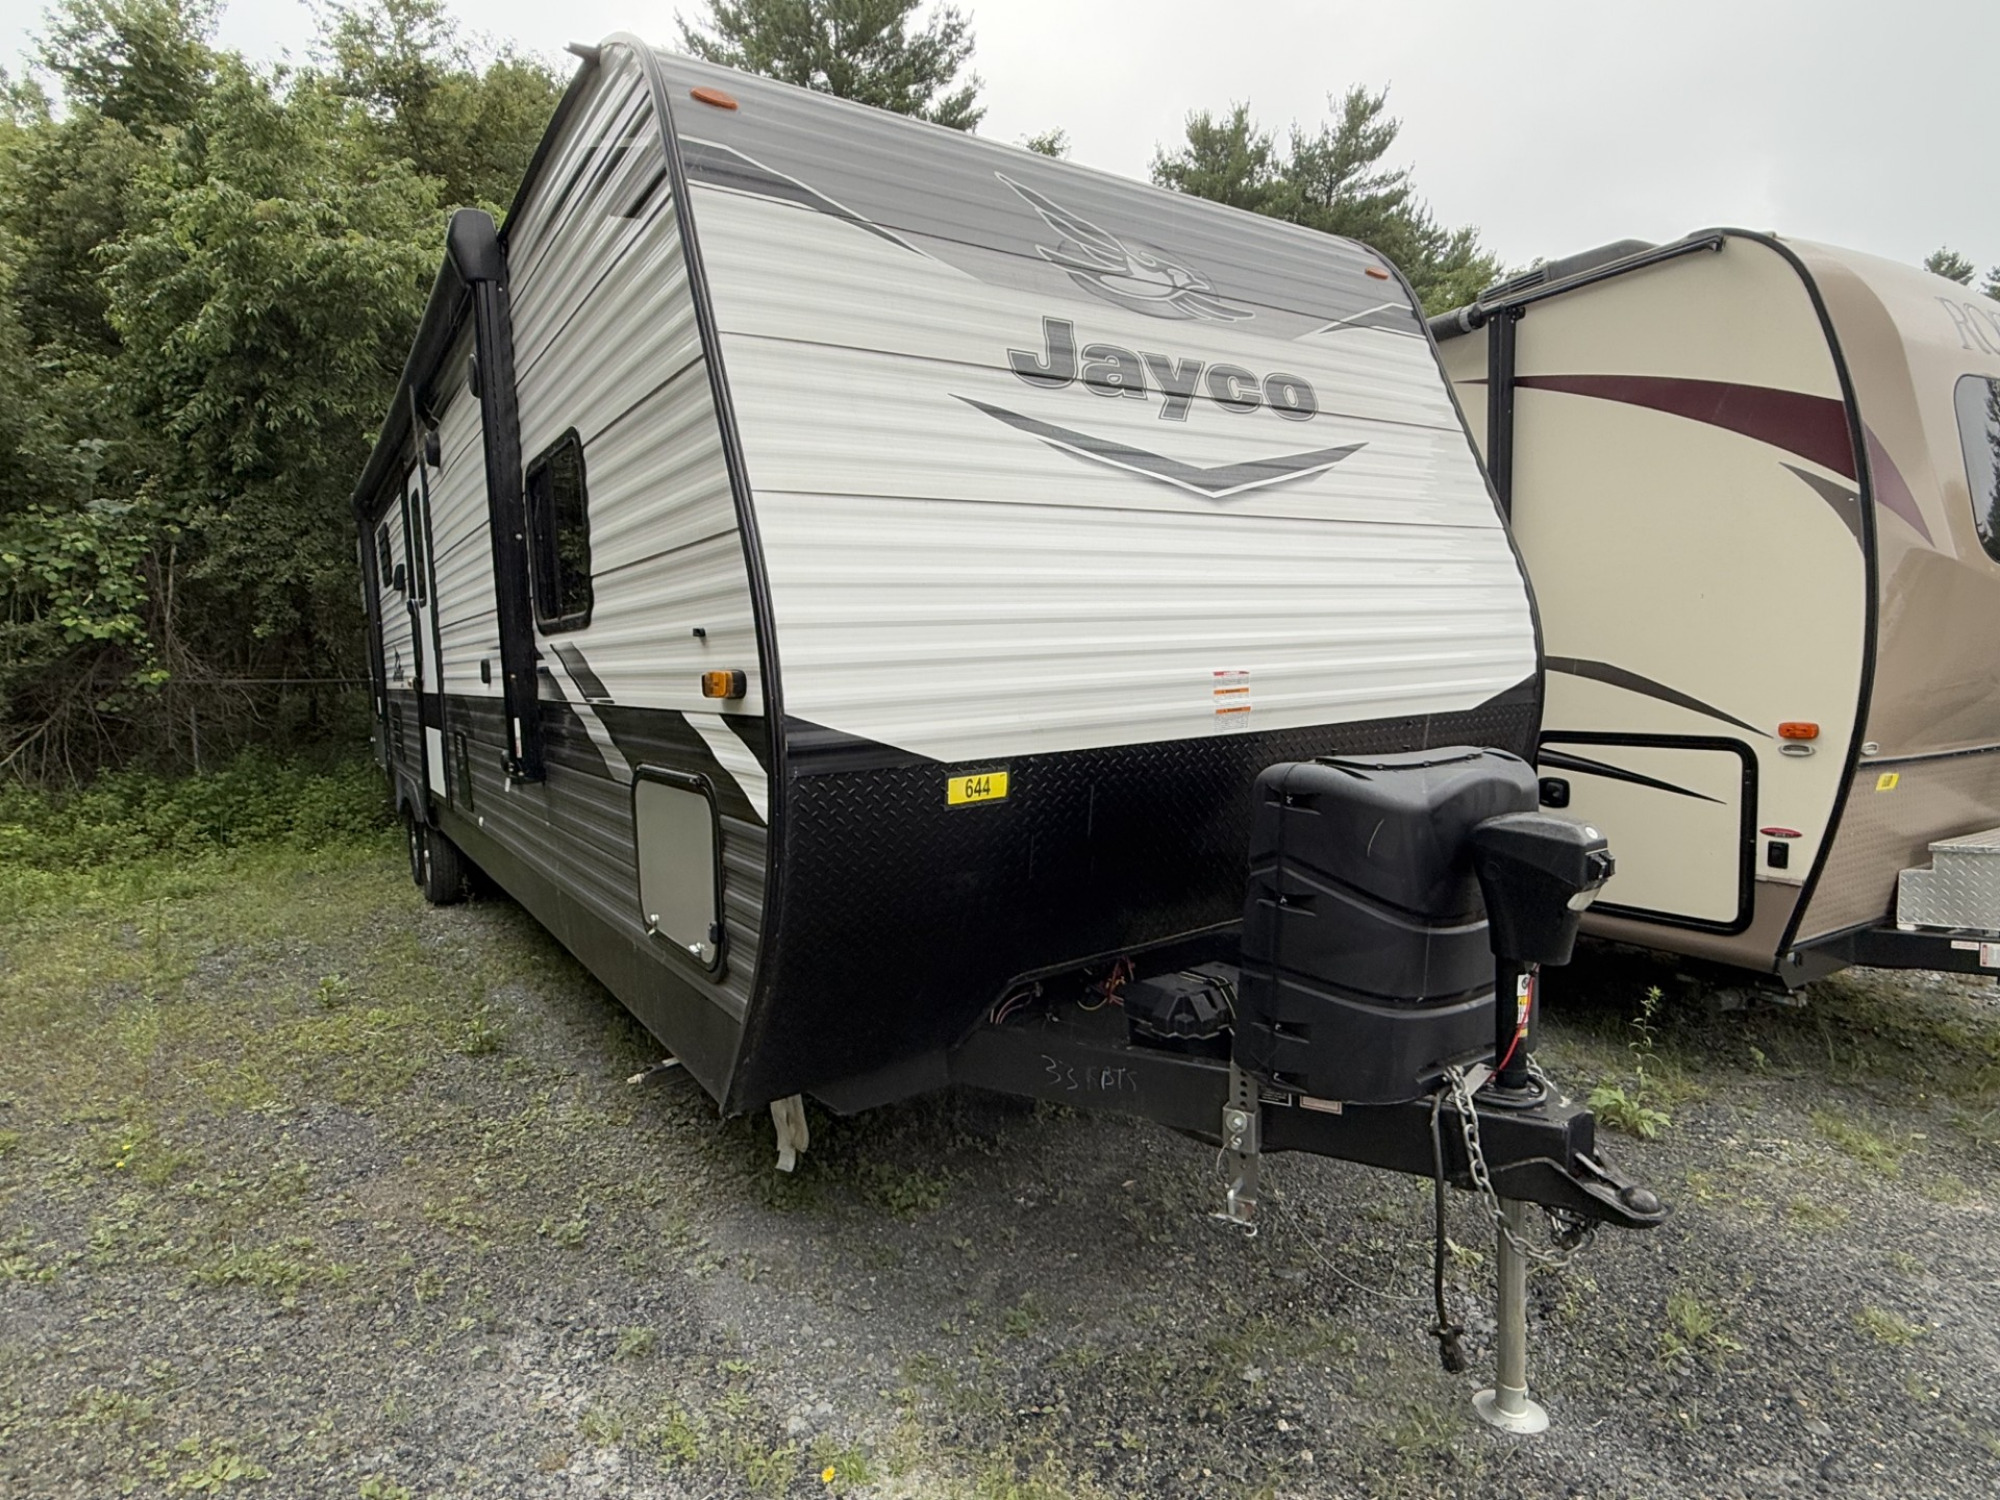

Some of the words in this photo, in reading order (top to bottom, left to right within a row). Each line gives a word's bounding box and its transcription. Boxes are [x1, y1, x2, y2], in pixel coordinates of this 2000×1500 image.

[1934, 296, 2000, 355] RO
[1007, 316, 1317, 422] Jayco
[965, 776, 991, 798] 644
